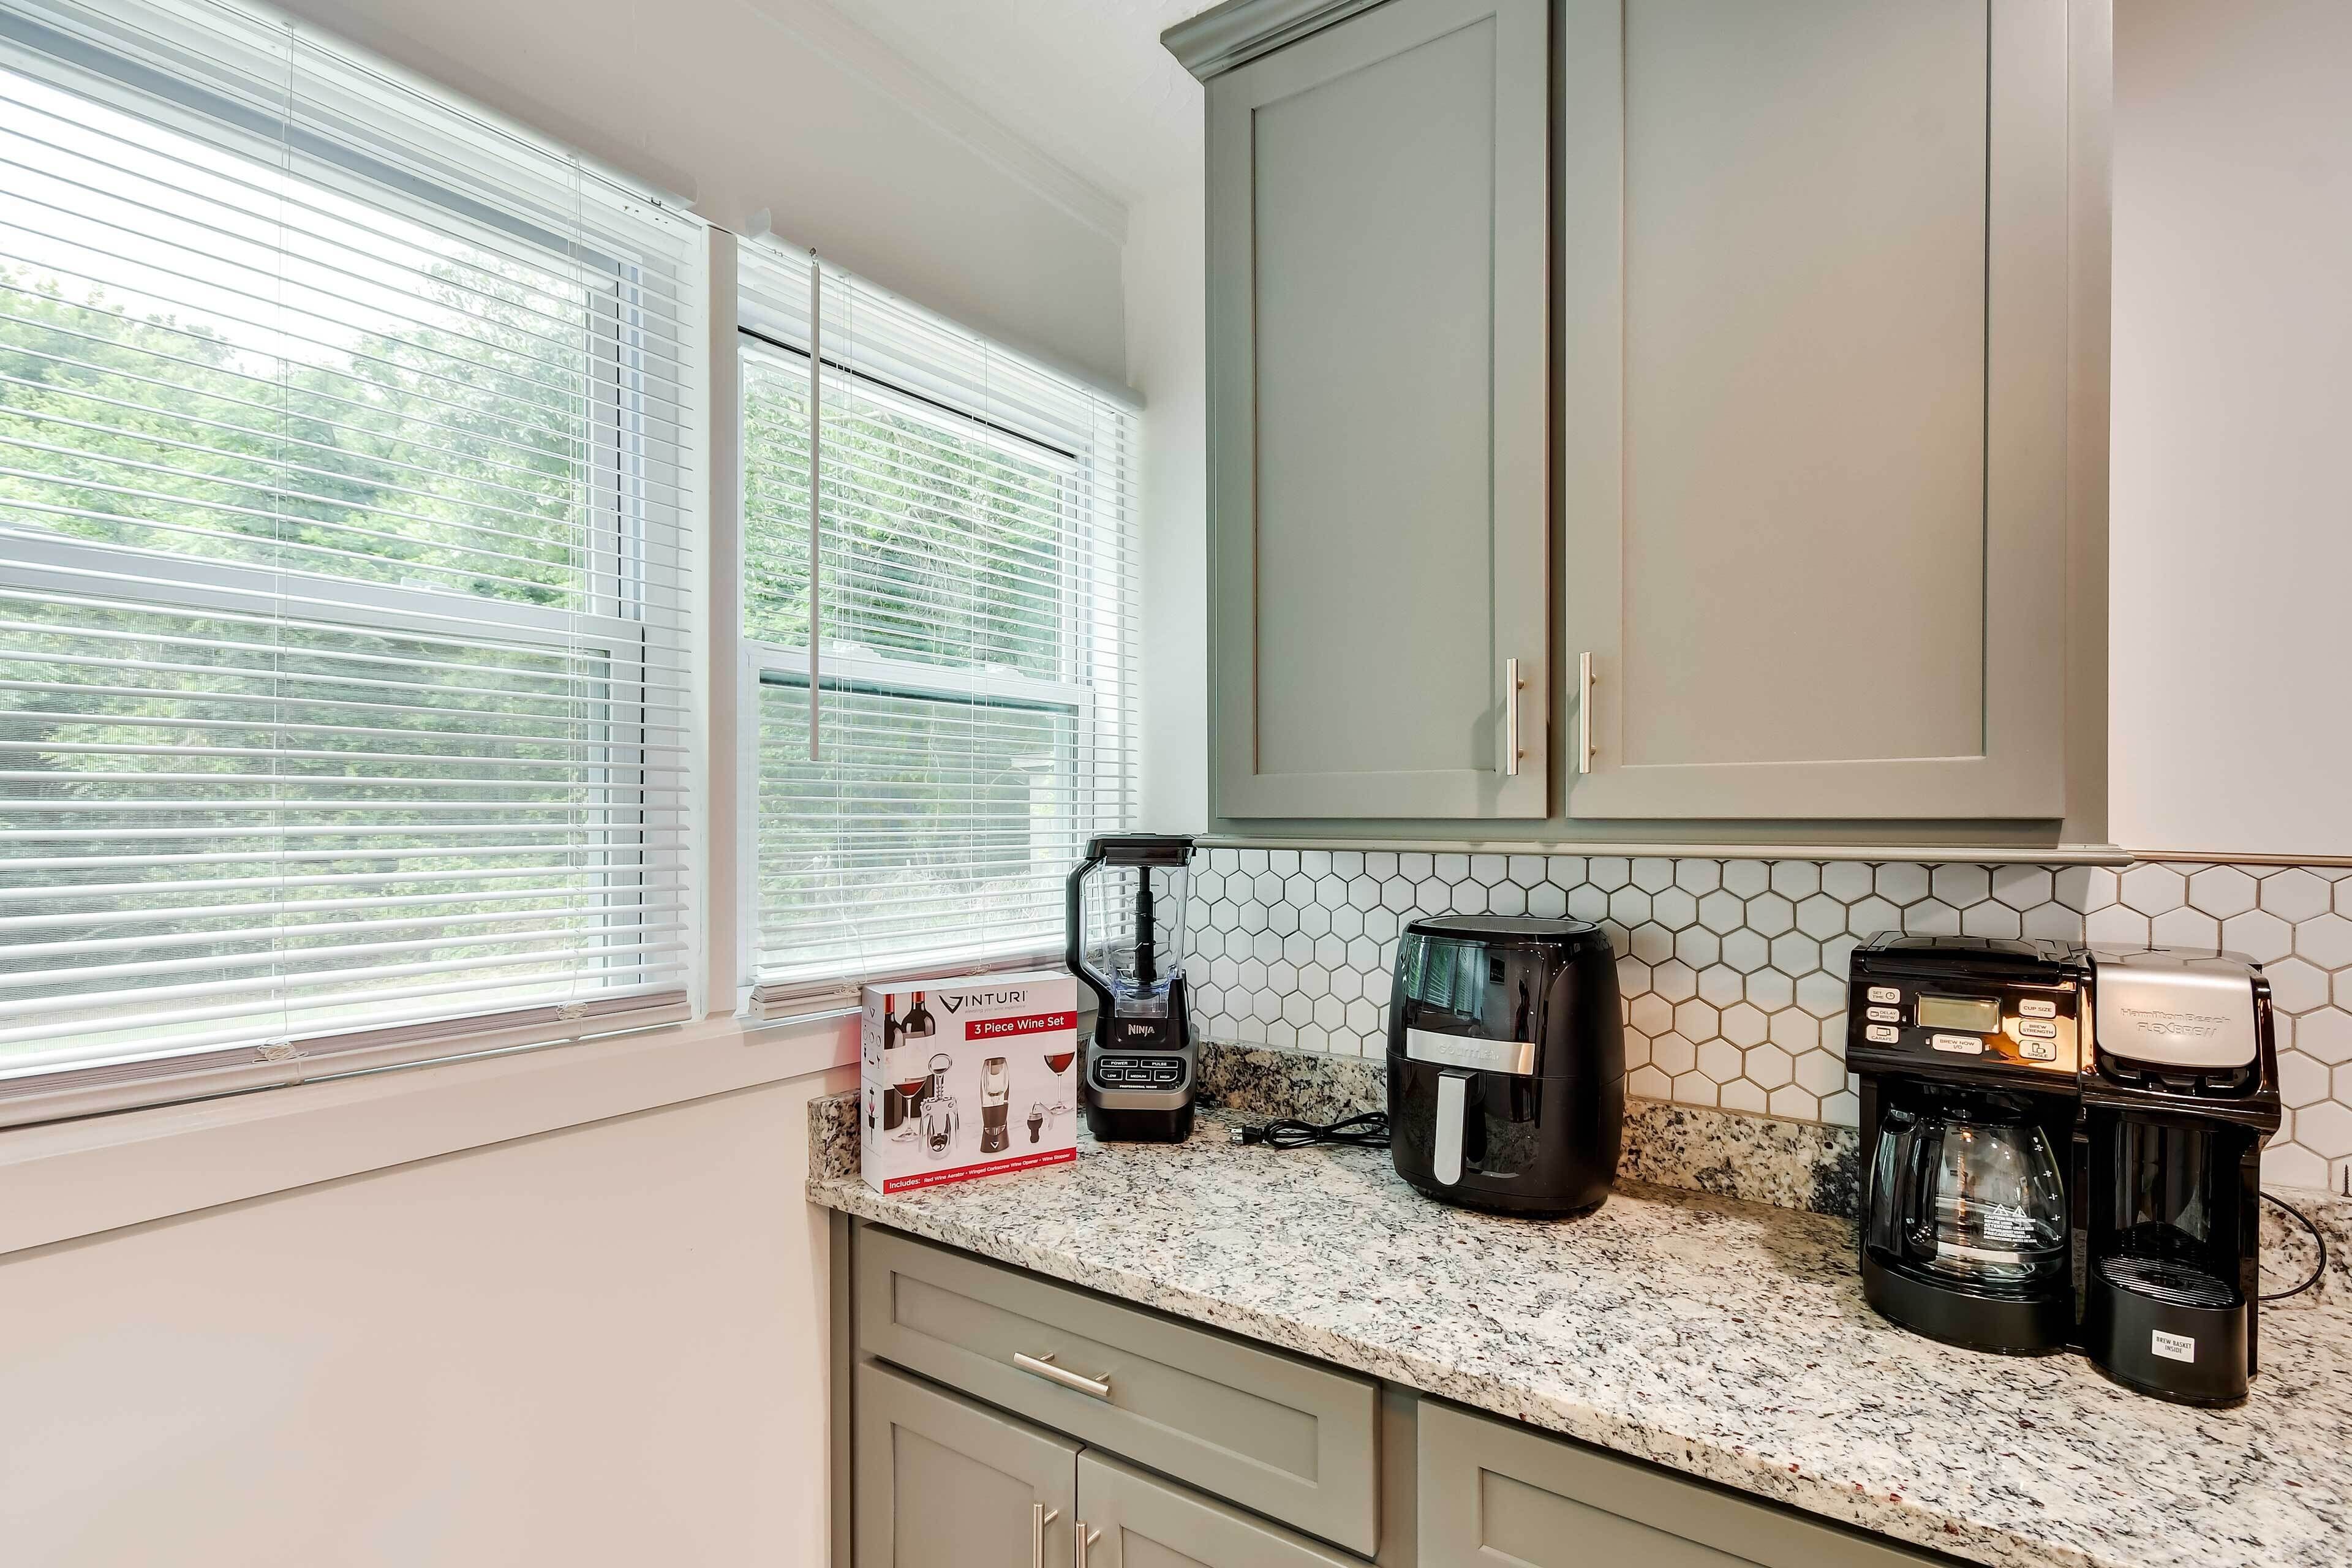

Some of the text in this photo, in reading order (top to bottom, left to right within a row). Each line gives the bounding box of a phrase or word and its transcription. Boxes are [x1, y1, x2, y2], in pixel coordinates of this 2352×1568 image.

[2120, 1008, 2231, 1023] Hamilton Beach
[974, 1016, 1065, 1035] 3 Piece Wine Set
[1128, 1023, 1155, 1037] NINJA
[889, 1178, 921, 1189] Includes:
[2156, 1336, 2192, 1349] BREW BASKET
[2165, 1344, 2183, 1354] INSIDE
